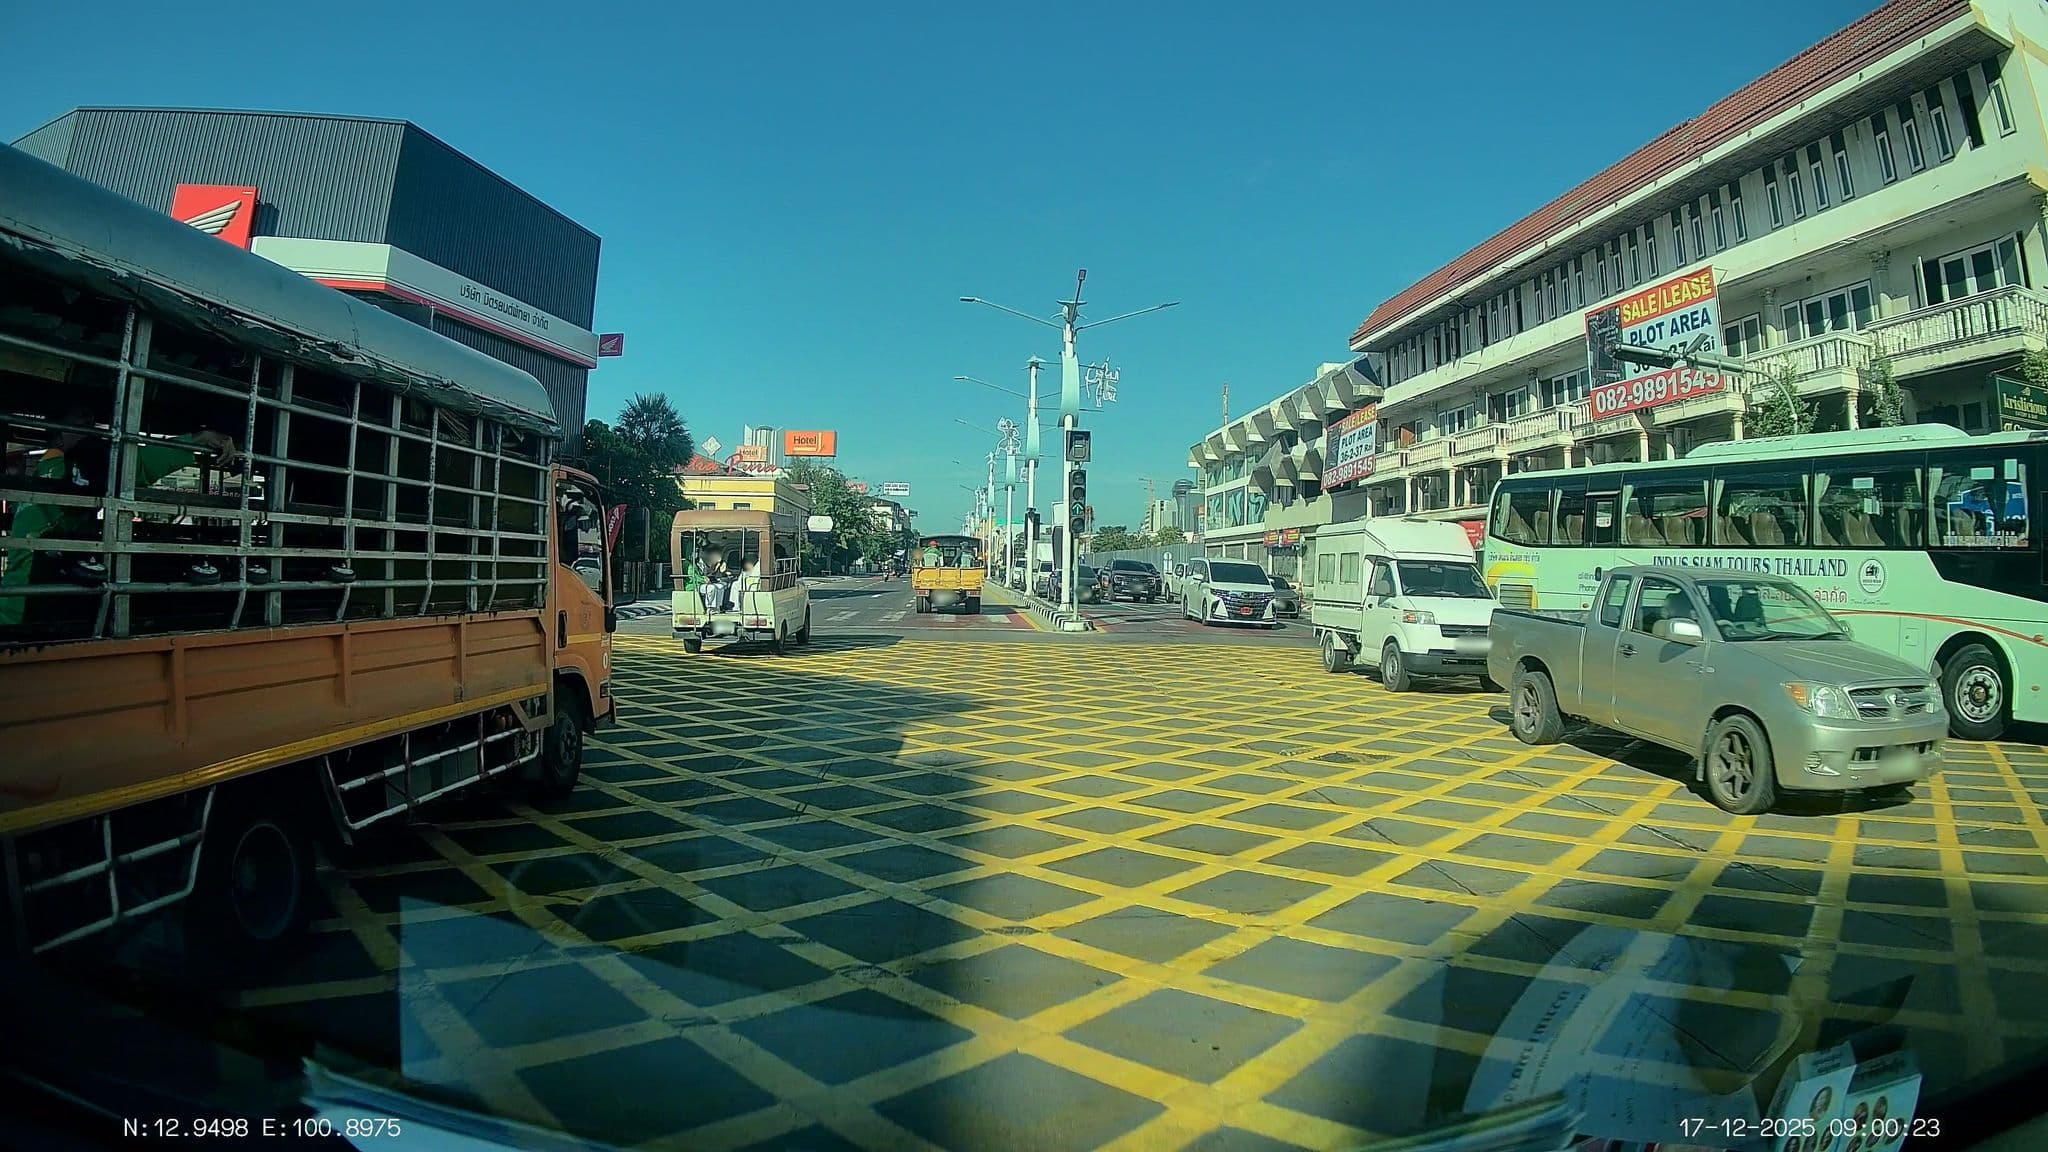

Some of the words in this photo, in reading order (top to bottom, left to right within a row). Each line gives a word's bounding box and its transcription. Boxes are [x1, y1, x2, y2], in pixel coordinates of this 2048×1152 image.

[460, 285, 481, 301] บริษัท
[532, 313, 549, 330] จำกัด
[1622, 273, 1712, 323] SALE/LEASE
[1630, 321, 1665, 346] PLOT
[1670, 307, 1712, 337] AREA
[1595, 368, 1720, 414] 082-9891545
[1341, 406, 1375, 431] SALE/LEASE
[793, 435, 817, 445] Hotel
[1341, 431, 1356, 448] PLOT
[1357, 426, 1373, 442] AREA
[1323, 456, 1373, 487] 082-9891545
[1727, 557, 1770, 575] TOURS
[1775, 558, 1848, 577] THAILAND
[1814, 586, 1848, 603] จำกัด
